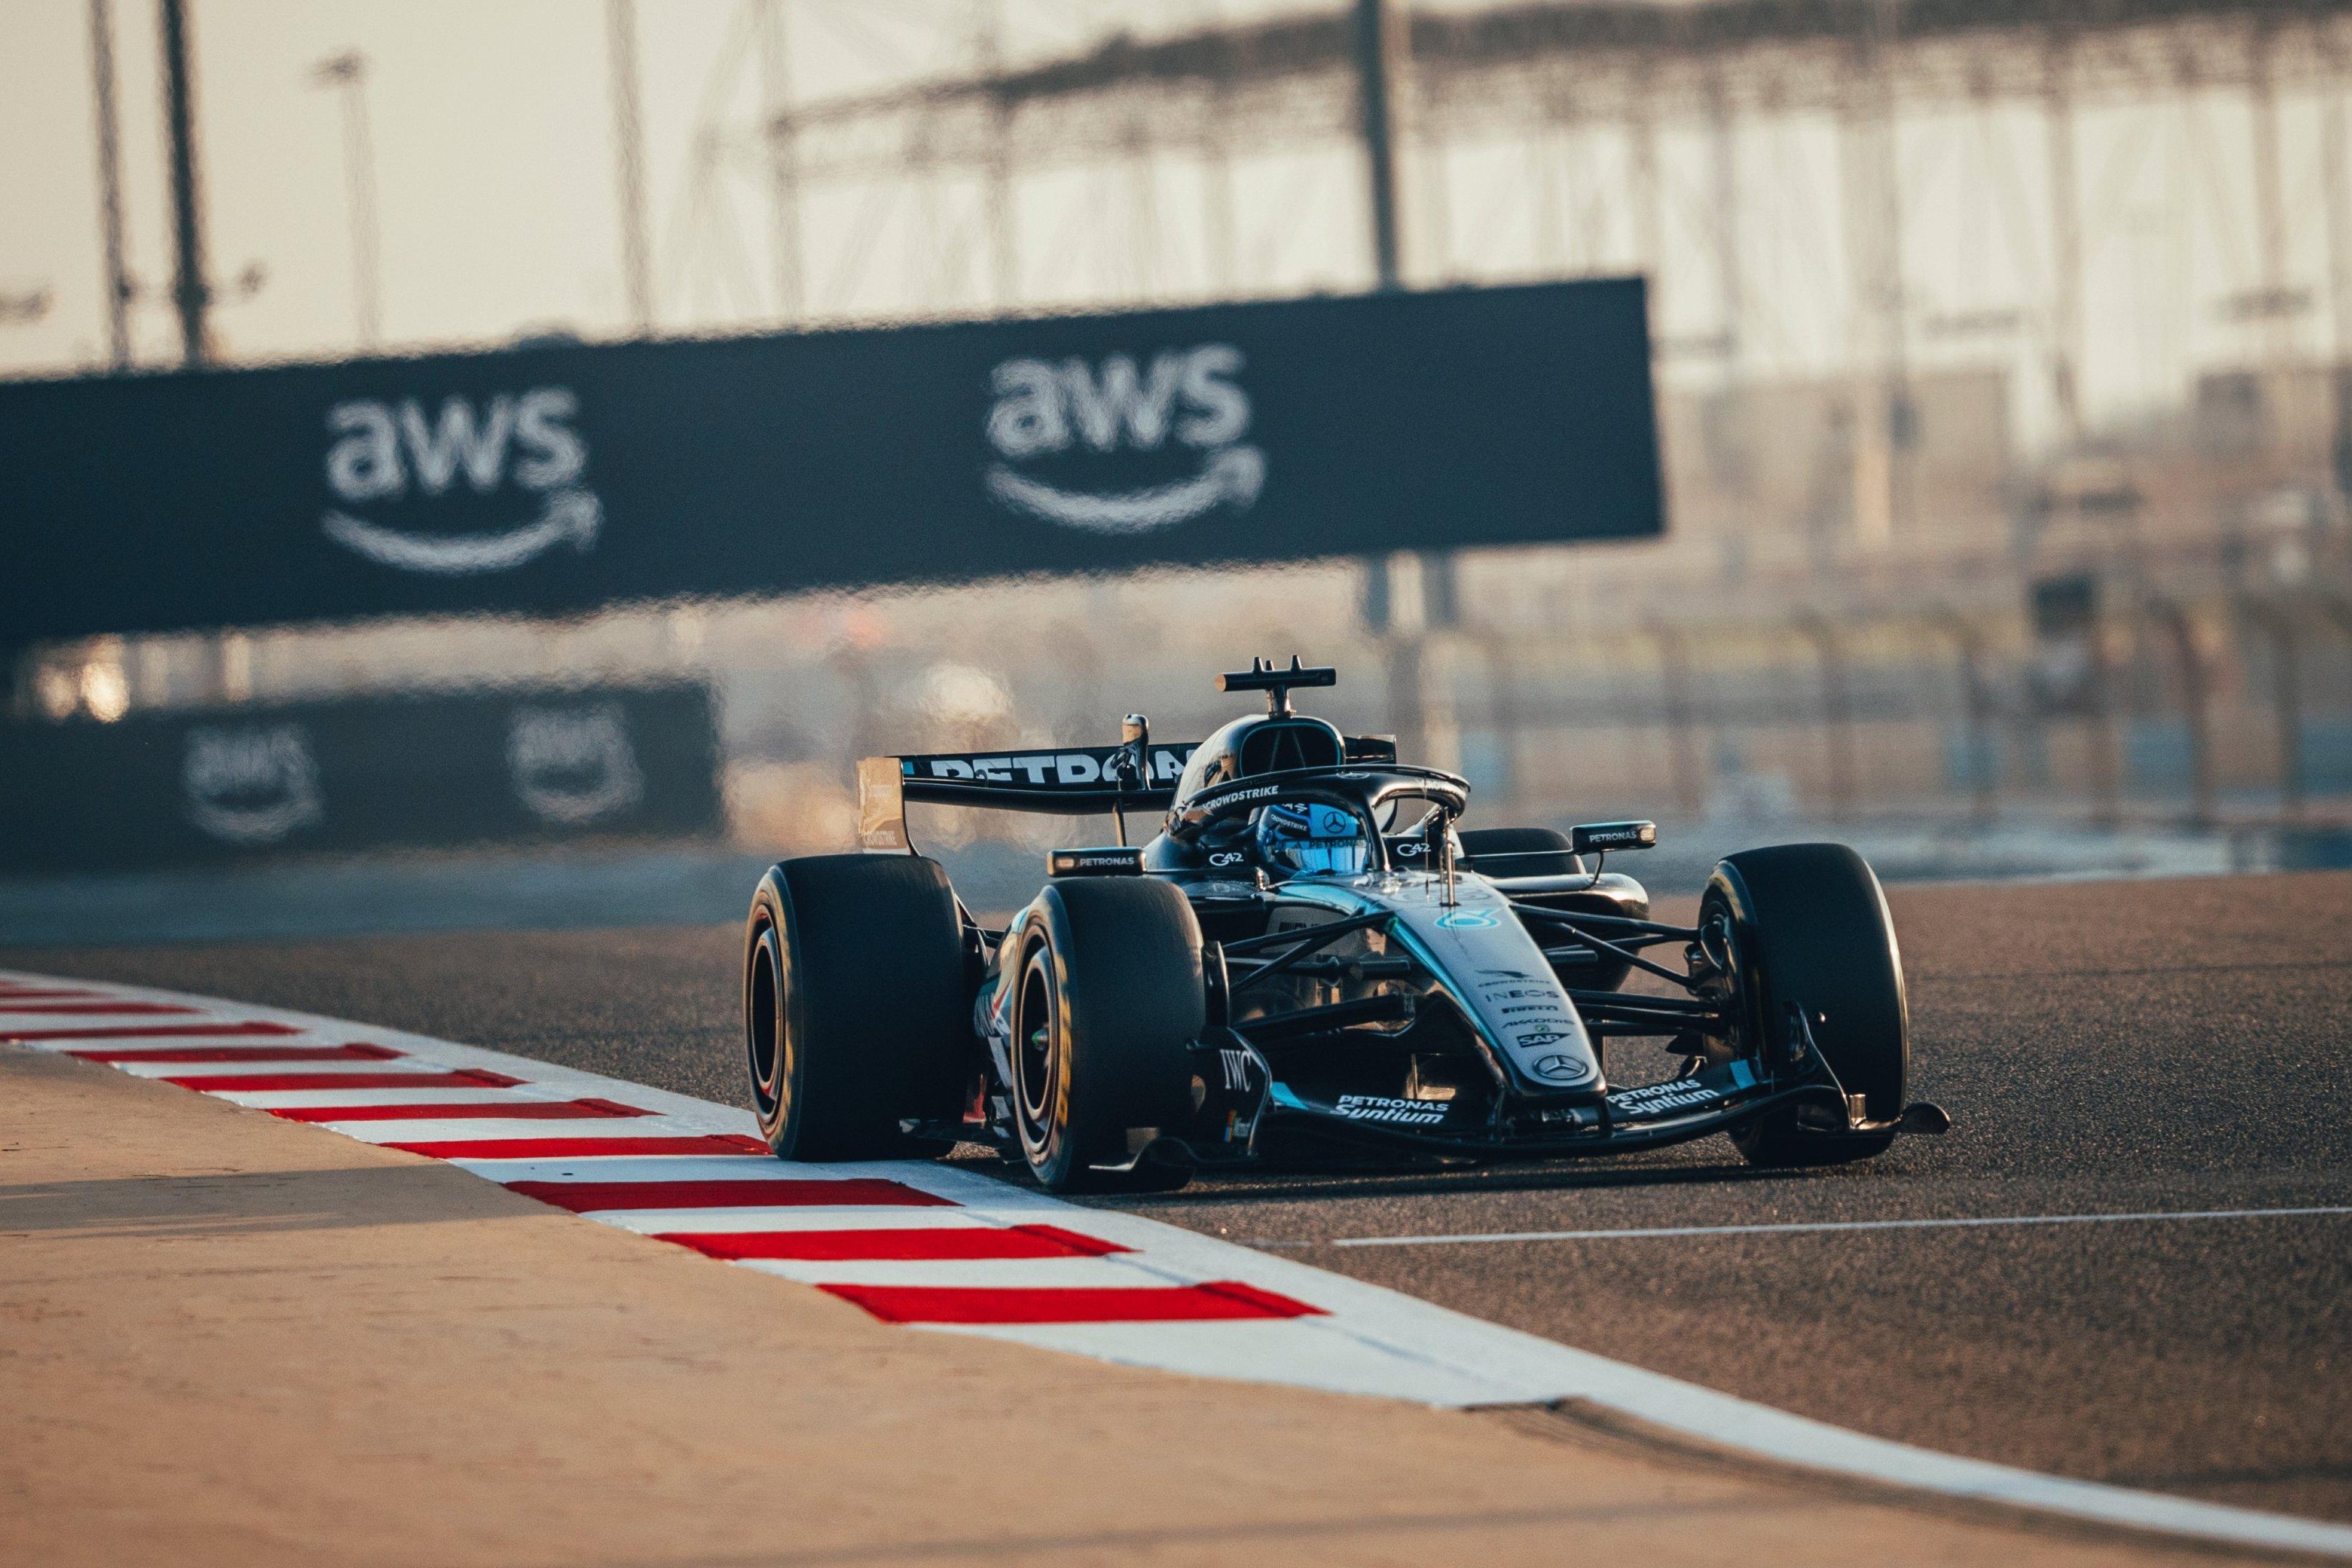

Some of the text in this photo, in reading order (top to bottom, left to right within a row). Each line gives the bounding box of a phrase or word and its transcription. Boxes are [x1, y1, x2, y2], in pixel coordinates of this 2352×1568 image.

[987, 345, 1250, 457] aws
[325, 386, 587, 501] aws
[1205, 785, 1279, 811] CROWDSTRIKE
[1590, 831, 1636, 843] PETRONAS
[1079, 857, 1135, 867] PETRONAS
[1209, 852, 1244, 867] G42
[1485, 989, 1560, 1002] INEOS
[1519, 1034, 1561, 1046] SAP
[1220, 1049, 1251, 1093] IWC
[1606, 1079, 1702, 1103] PETRONAS
[1618, 1089, 1721, 1114] Syntium
[1329, 1103, 1445, 1124] Syntium
[1339, 1095, 1450, 1111] PETRONAS
